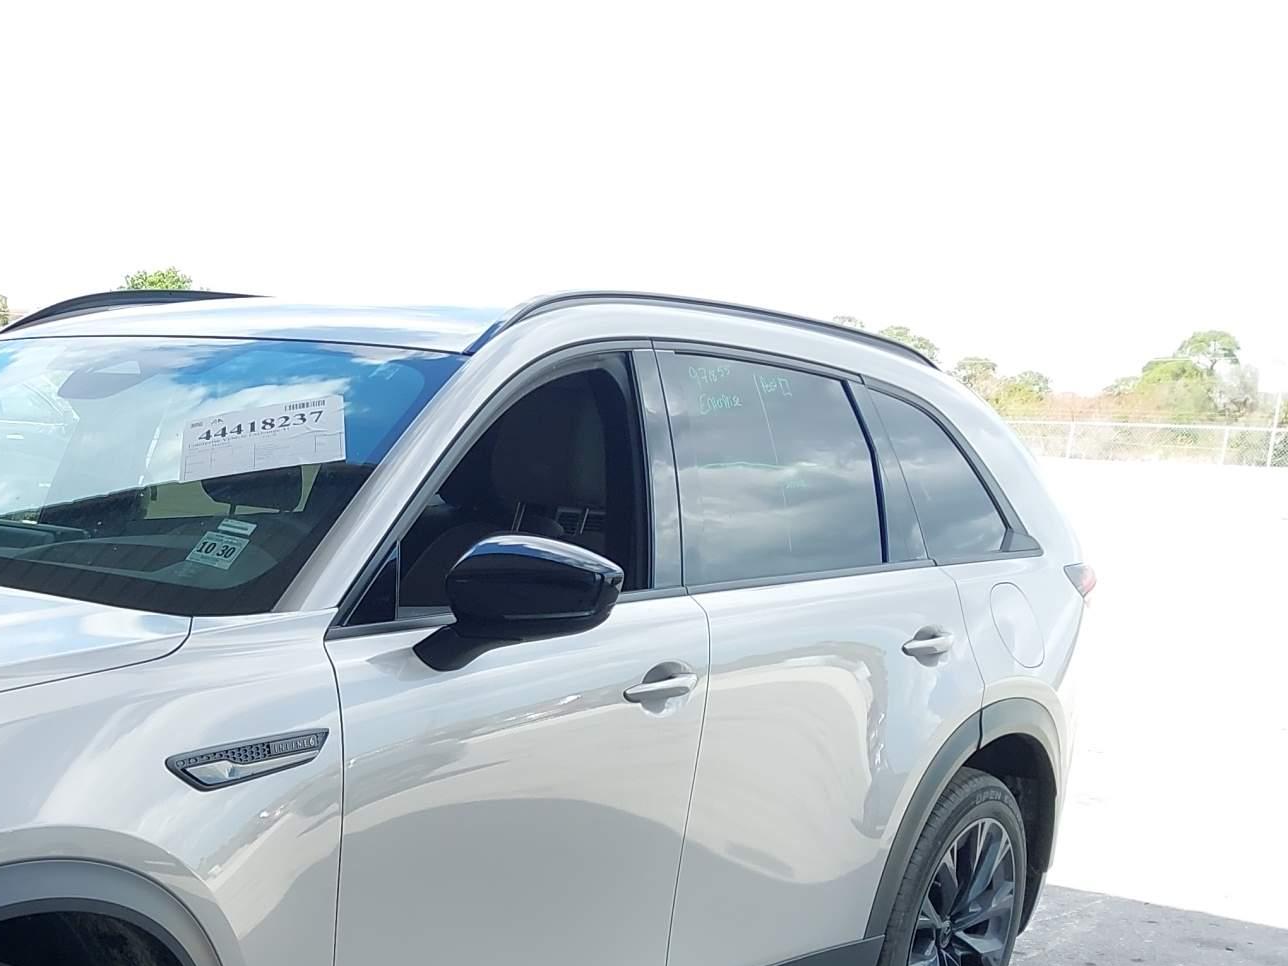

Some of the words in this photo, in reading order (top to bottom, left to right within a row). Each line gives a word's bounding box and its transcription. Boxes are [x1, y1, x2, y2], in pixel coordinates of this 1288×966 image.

[197, 410, 325, 442] 44418237
[196, 541, 217, 554] 10
[216, 544, 236, 559] 30
